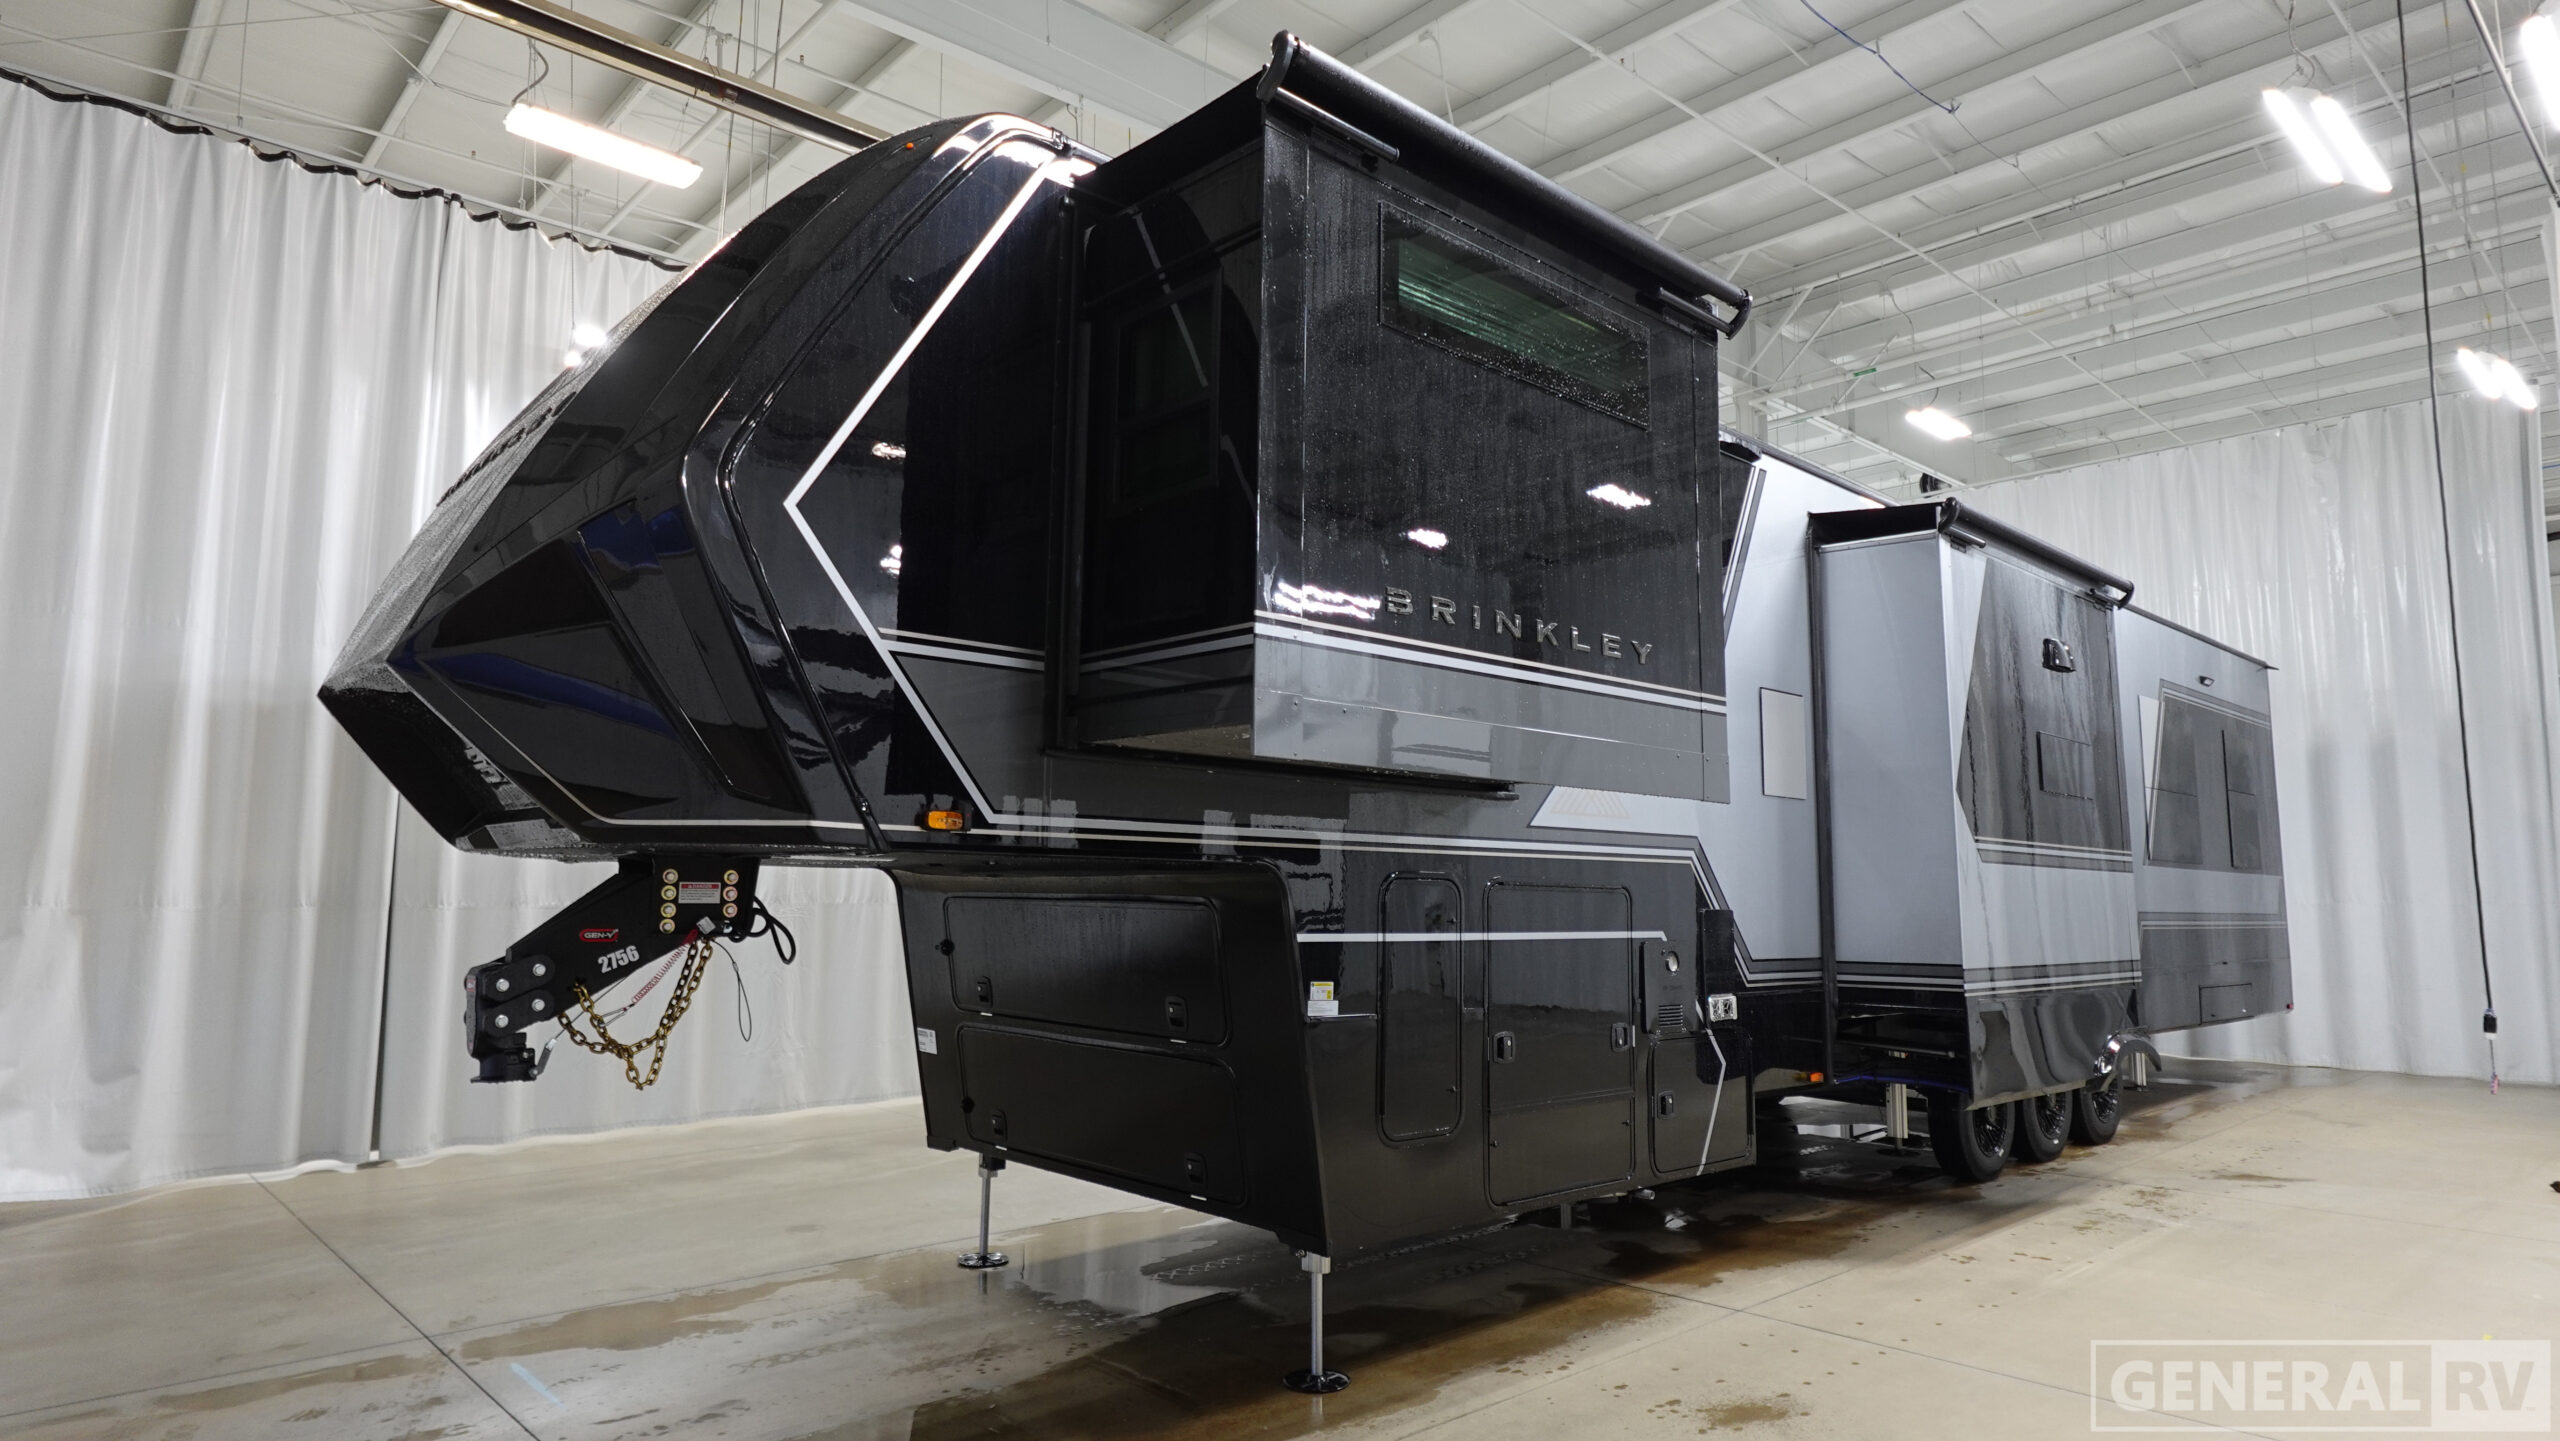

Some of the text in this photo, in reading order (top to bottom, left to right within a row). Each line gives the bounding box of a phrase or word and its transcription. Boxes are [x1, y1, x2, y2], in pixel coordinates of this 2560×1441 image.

[1385, 585, 1653, 665] BRINKLEY
[583, 928, 619, 939] GEN-Y
[597, 945, 640, 974] 2756
